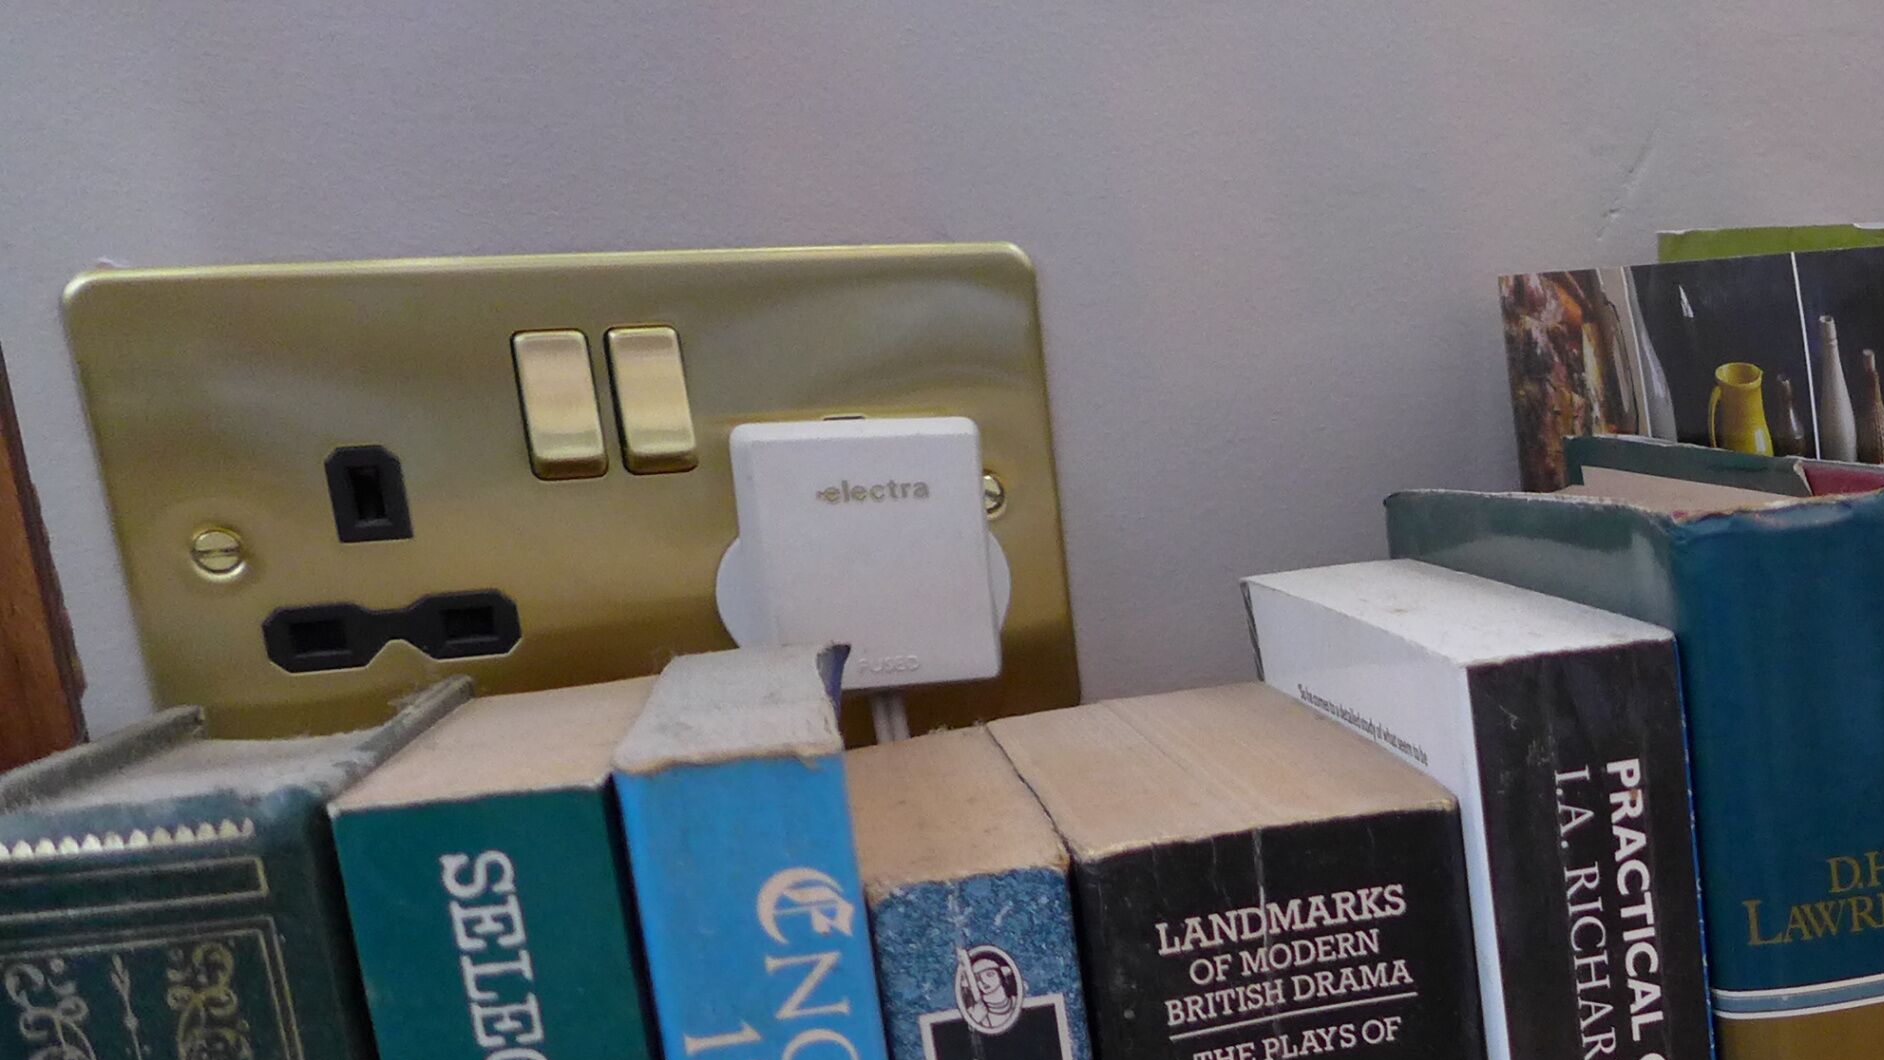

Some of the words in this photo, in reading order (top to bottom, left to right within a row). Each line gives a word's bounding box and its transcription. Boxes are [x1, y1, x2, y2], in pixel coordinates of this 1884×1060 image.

[823, 479, 930, 504] electra
[858, 654, 920, 675] FUSED
[1155, 883, 1408, 957] LANDMARKS
[1606, 757, 1664, 1042] PRACTICAL
[1189, 953, 1232, 986] OF
[1240, 929, 1381, 975] MODERN
[1164, 978, 1286, 1027] BRITISH
[1293, 959, 1414, 1002] DRAMA
[1361, 1017, 1402, 1045] OF
